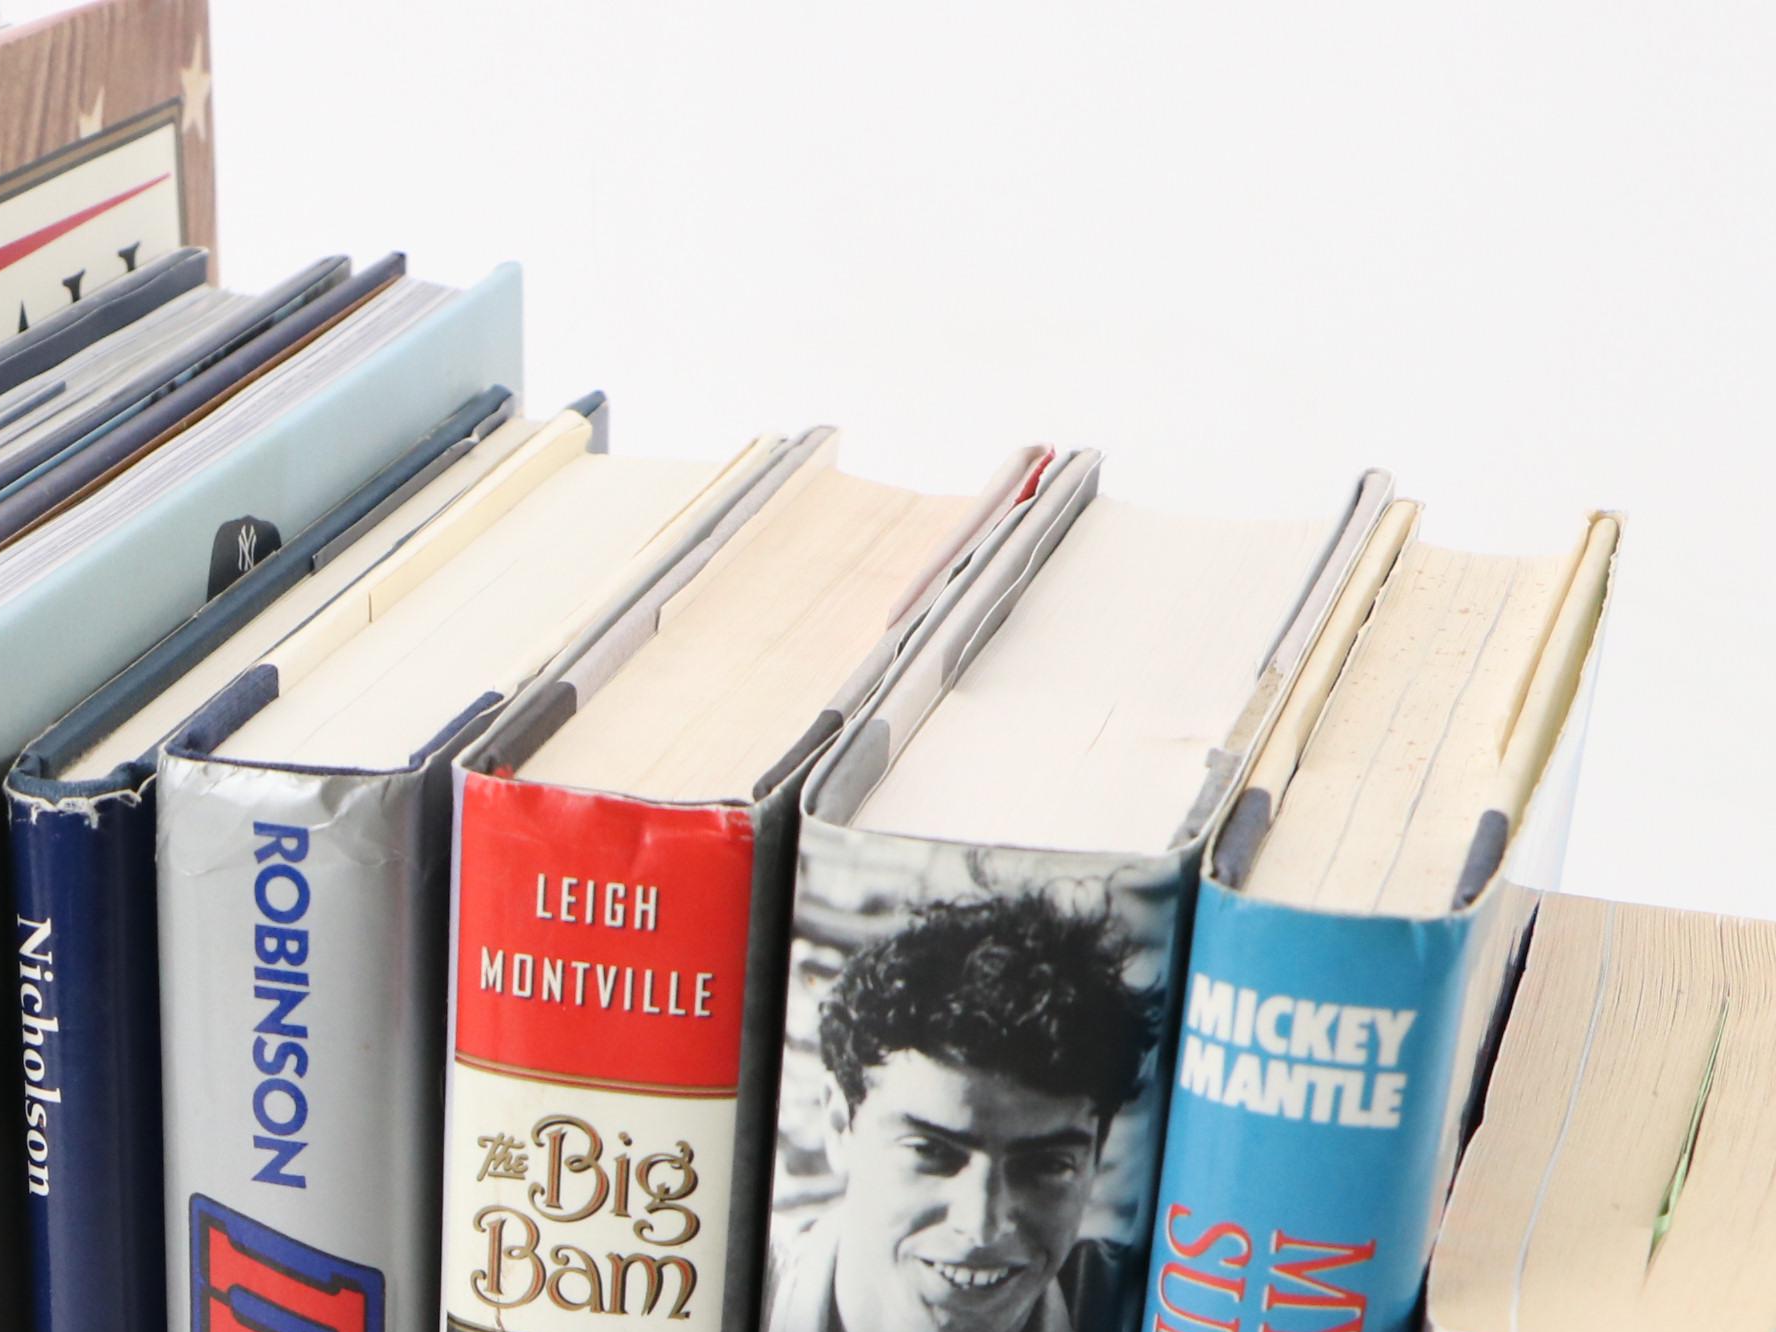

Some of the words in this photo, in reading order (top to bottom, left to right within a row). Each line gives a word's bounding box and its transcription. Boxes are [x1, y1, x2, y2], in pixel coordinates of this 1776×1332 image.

[535, 872, 659, 932] LEIGH
[252, 821, 311, 1189] ROBINSON
[480, 946, 714, 1018] MONTVILLE
[1187, 972, 1417, 1069] MICKEY
[16, 913, 61, 1198] Nicholson
[1180, 1033, 1408, 1131] MANTLE
[528, 1113, 701, 1247] Big
[470, 1204, 698, 1320] Bam
